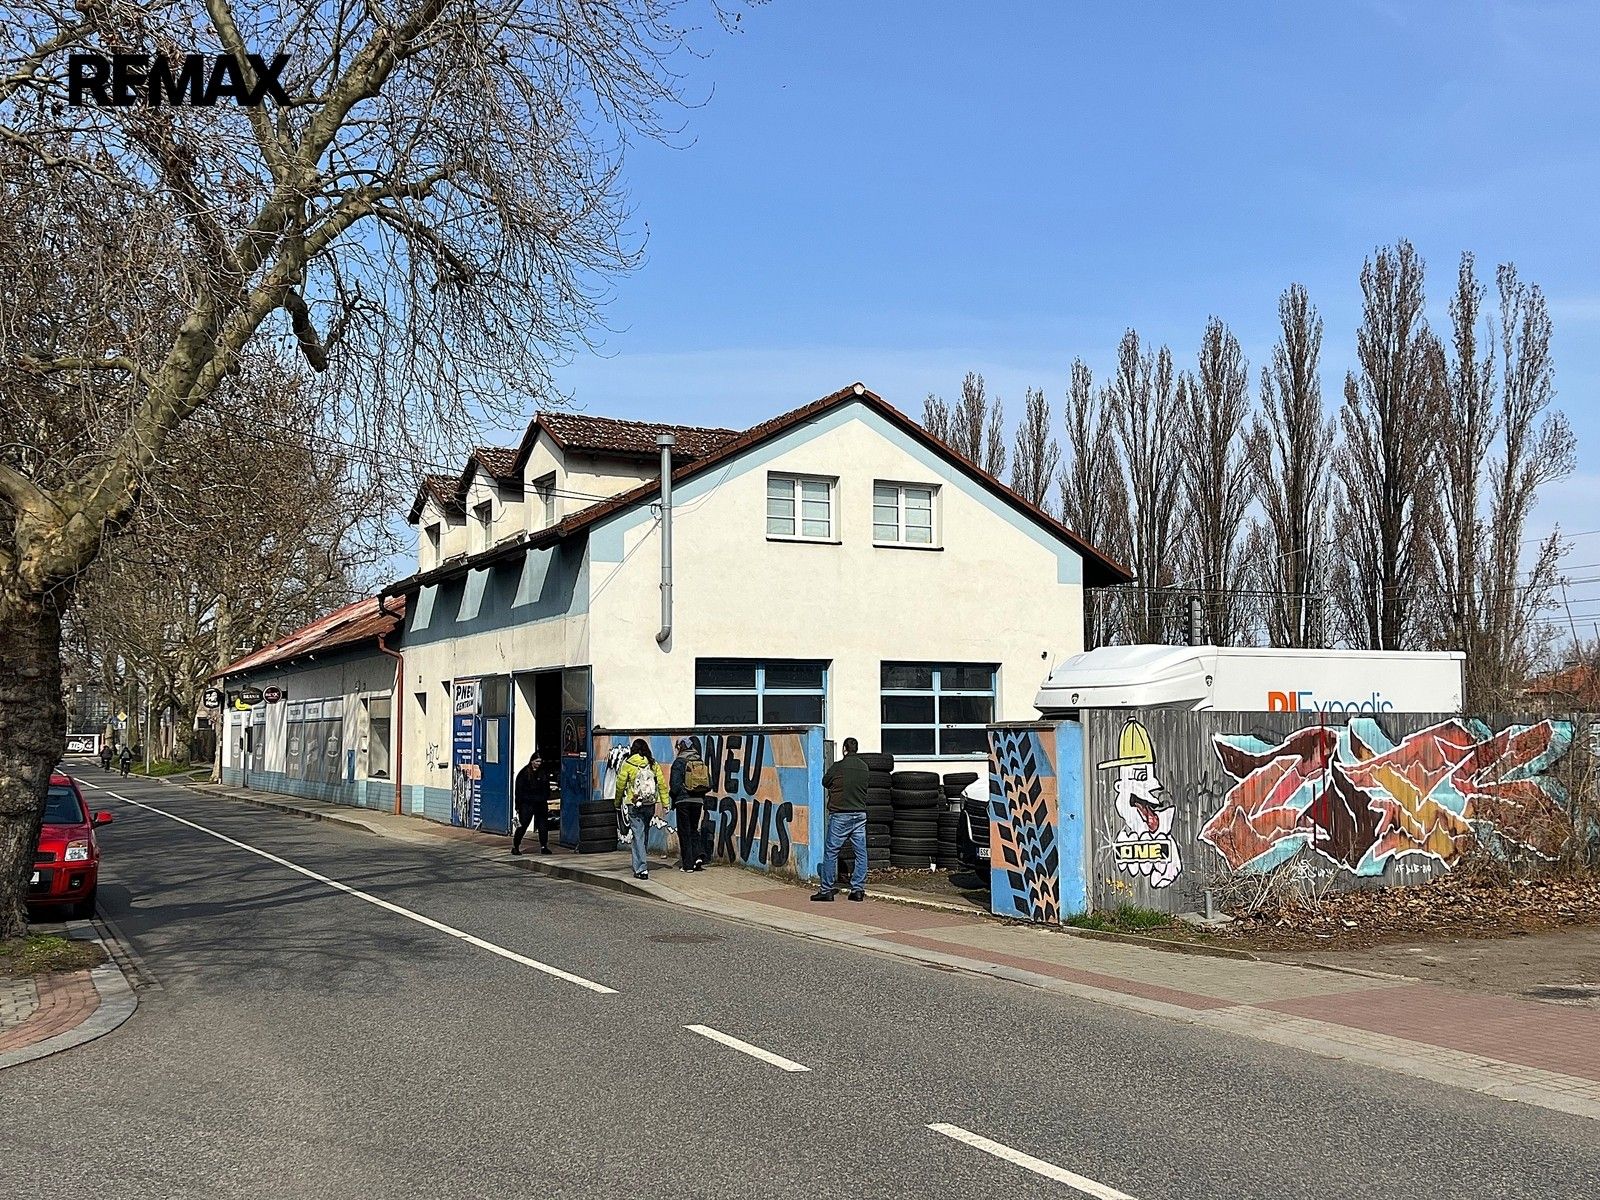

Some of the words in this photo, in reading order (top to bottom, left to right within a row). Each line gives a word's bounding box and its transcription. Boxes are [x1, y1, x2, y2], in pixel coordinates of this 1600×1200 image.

[690, 734, 765, 796] NEU
[701, 796, 793, 867] ERVIS
[1120, 843, 1162, 860] ONE
